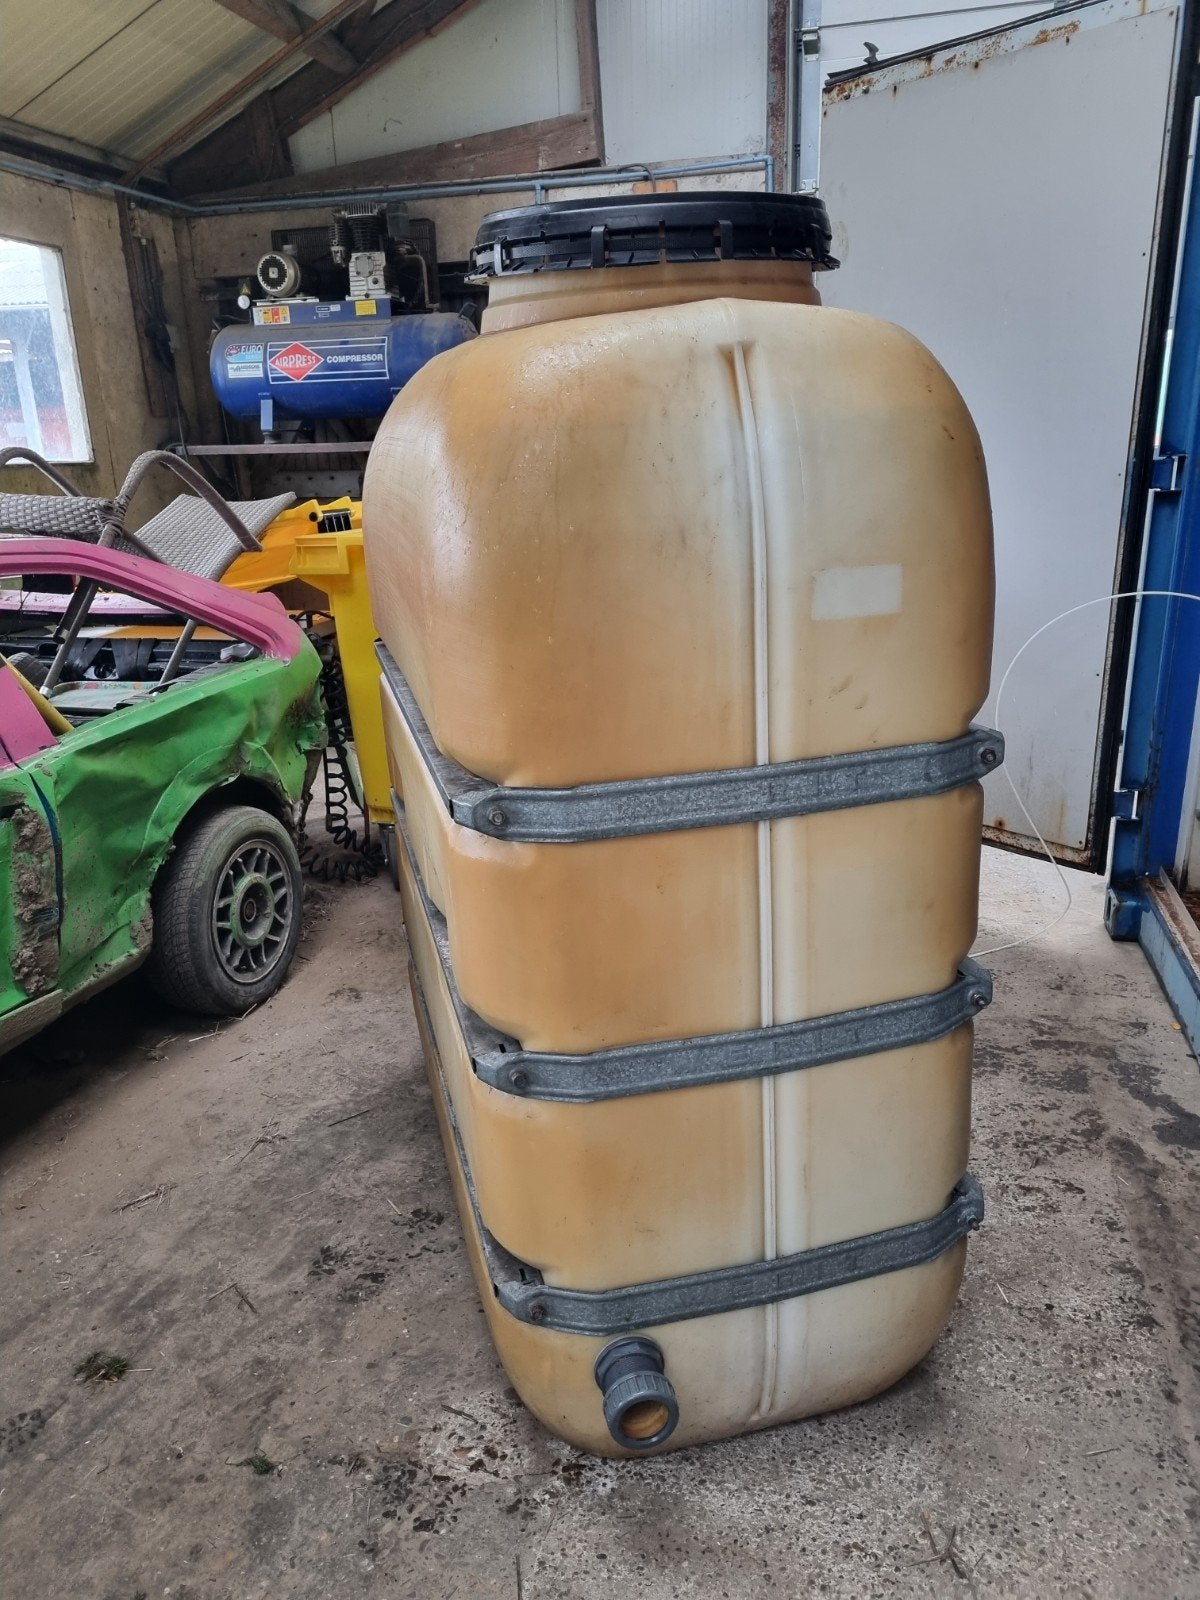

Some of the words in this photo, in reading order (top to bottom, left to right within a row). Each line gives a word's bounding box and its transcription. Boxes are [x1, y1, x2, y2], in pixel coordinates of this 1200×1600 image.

[241, 345, 263, 354] EURO
[275, 353, 316, 368] AIRPRESS
[326, 353, 384, 364] COMPRESSOR
